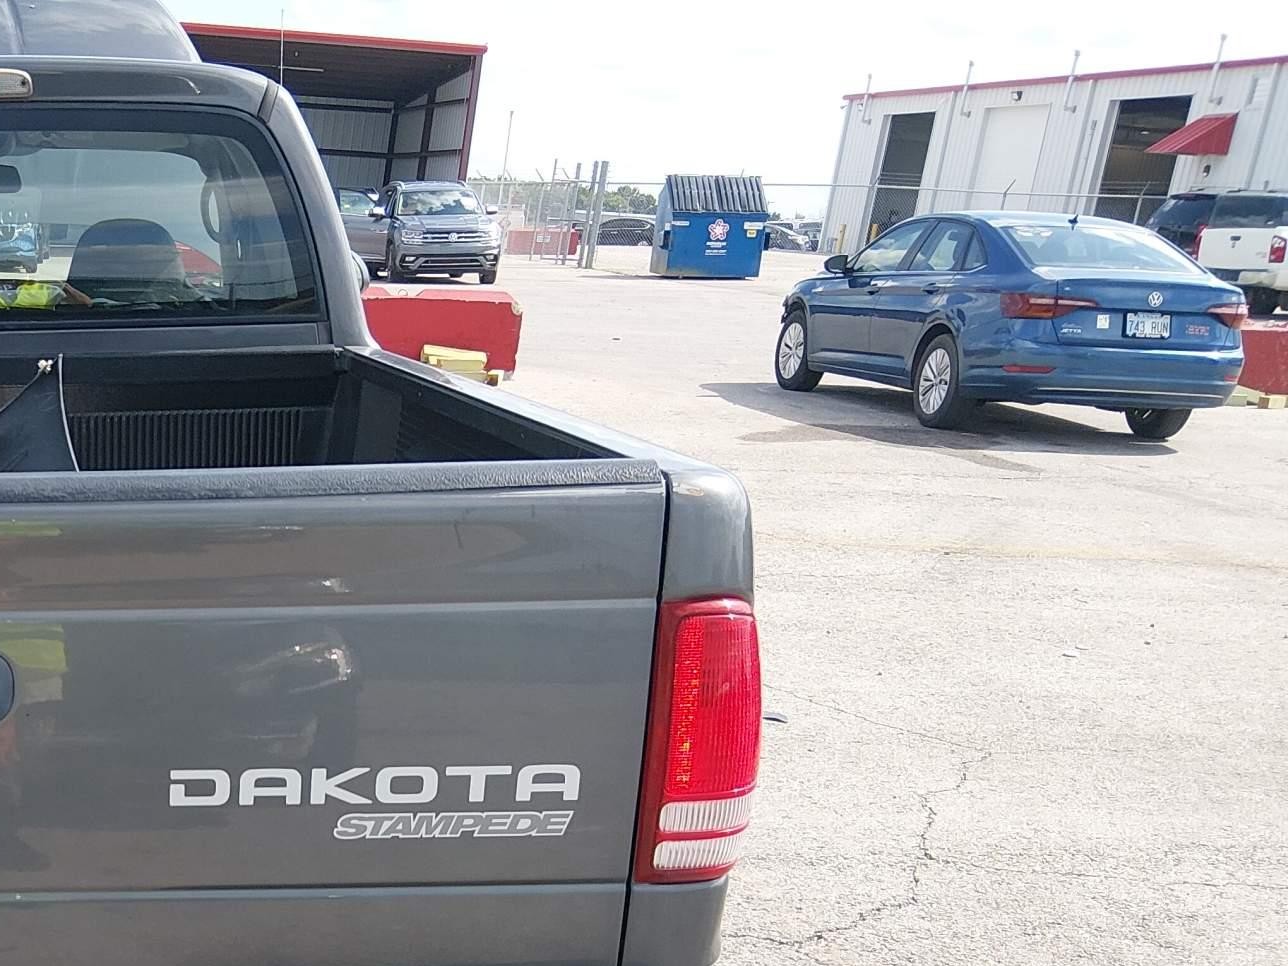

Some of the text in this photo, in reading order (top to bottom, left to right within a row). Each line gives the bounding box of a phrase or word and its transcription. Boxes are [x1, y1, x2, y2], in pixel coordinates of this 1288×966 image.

[1128, 320, 1169, 334] 743 RUN
[169, 764, 581, 806] DAKOTA
[333, 811, 574, 839] STAMPEDE
